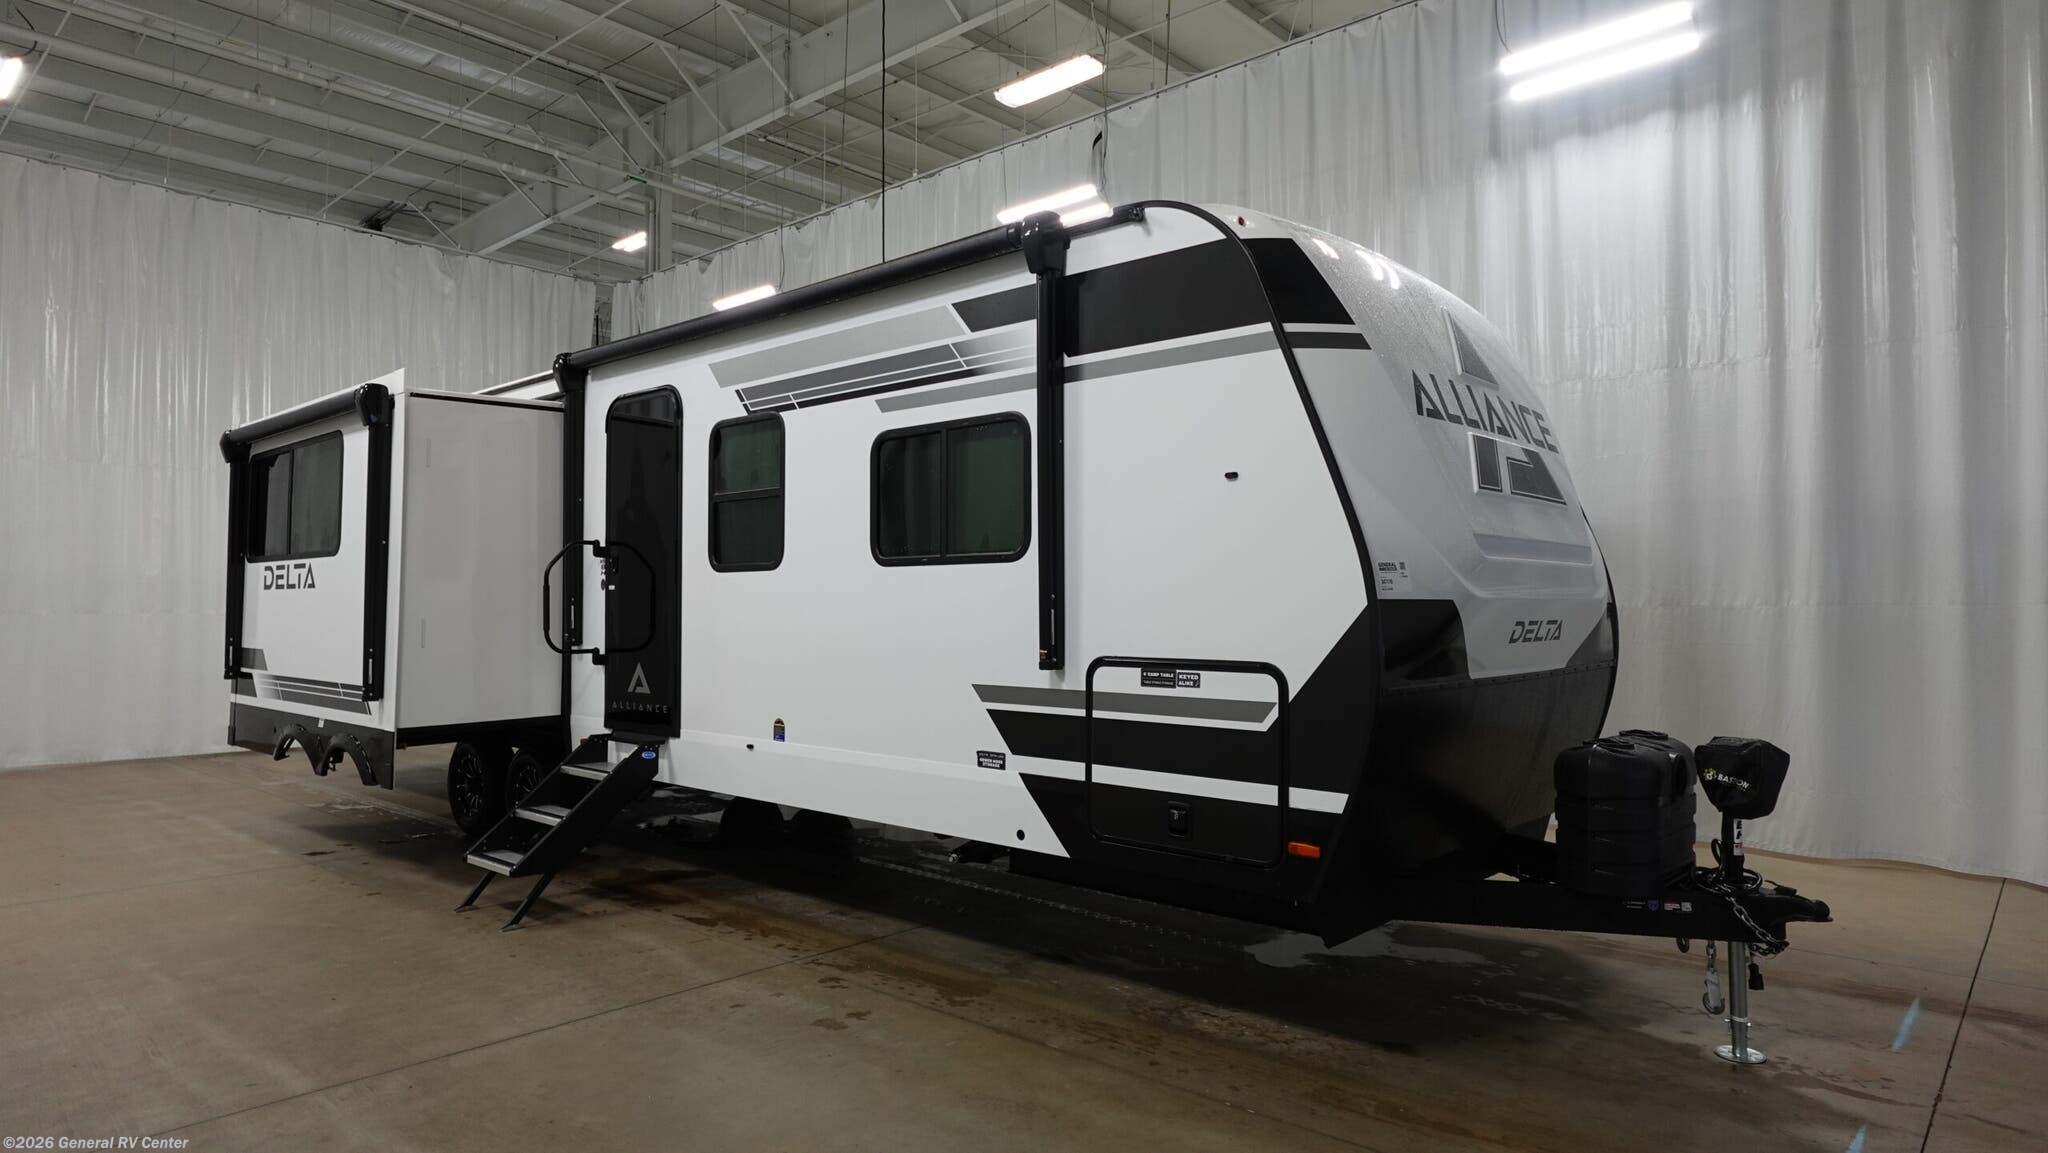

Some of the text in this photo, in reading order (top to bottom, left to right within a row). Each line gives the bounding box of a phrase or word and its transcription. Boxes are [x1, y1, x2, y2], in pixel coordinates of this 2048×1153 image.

[1412, 370, 1559, 454] ALLIANCE
[263, 562, 316, 590] DELTA
[1508, 620, 1563, 644] DELTA
[611, 701, 669, 714] ALLIANCE
